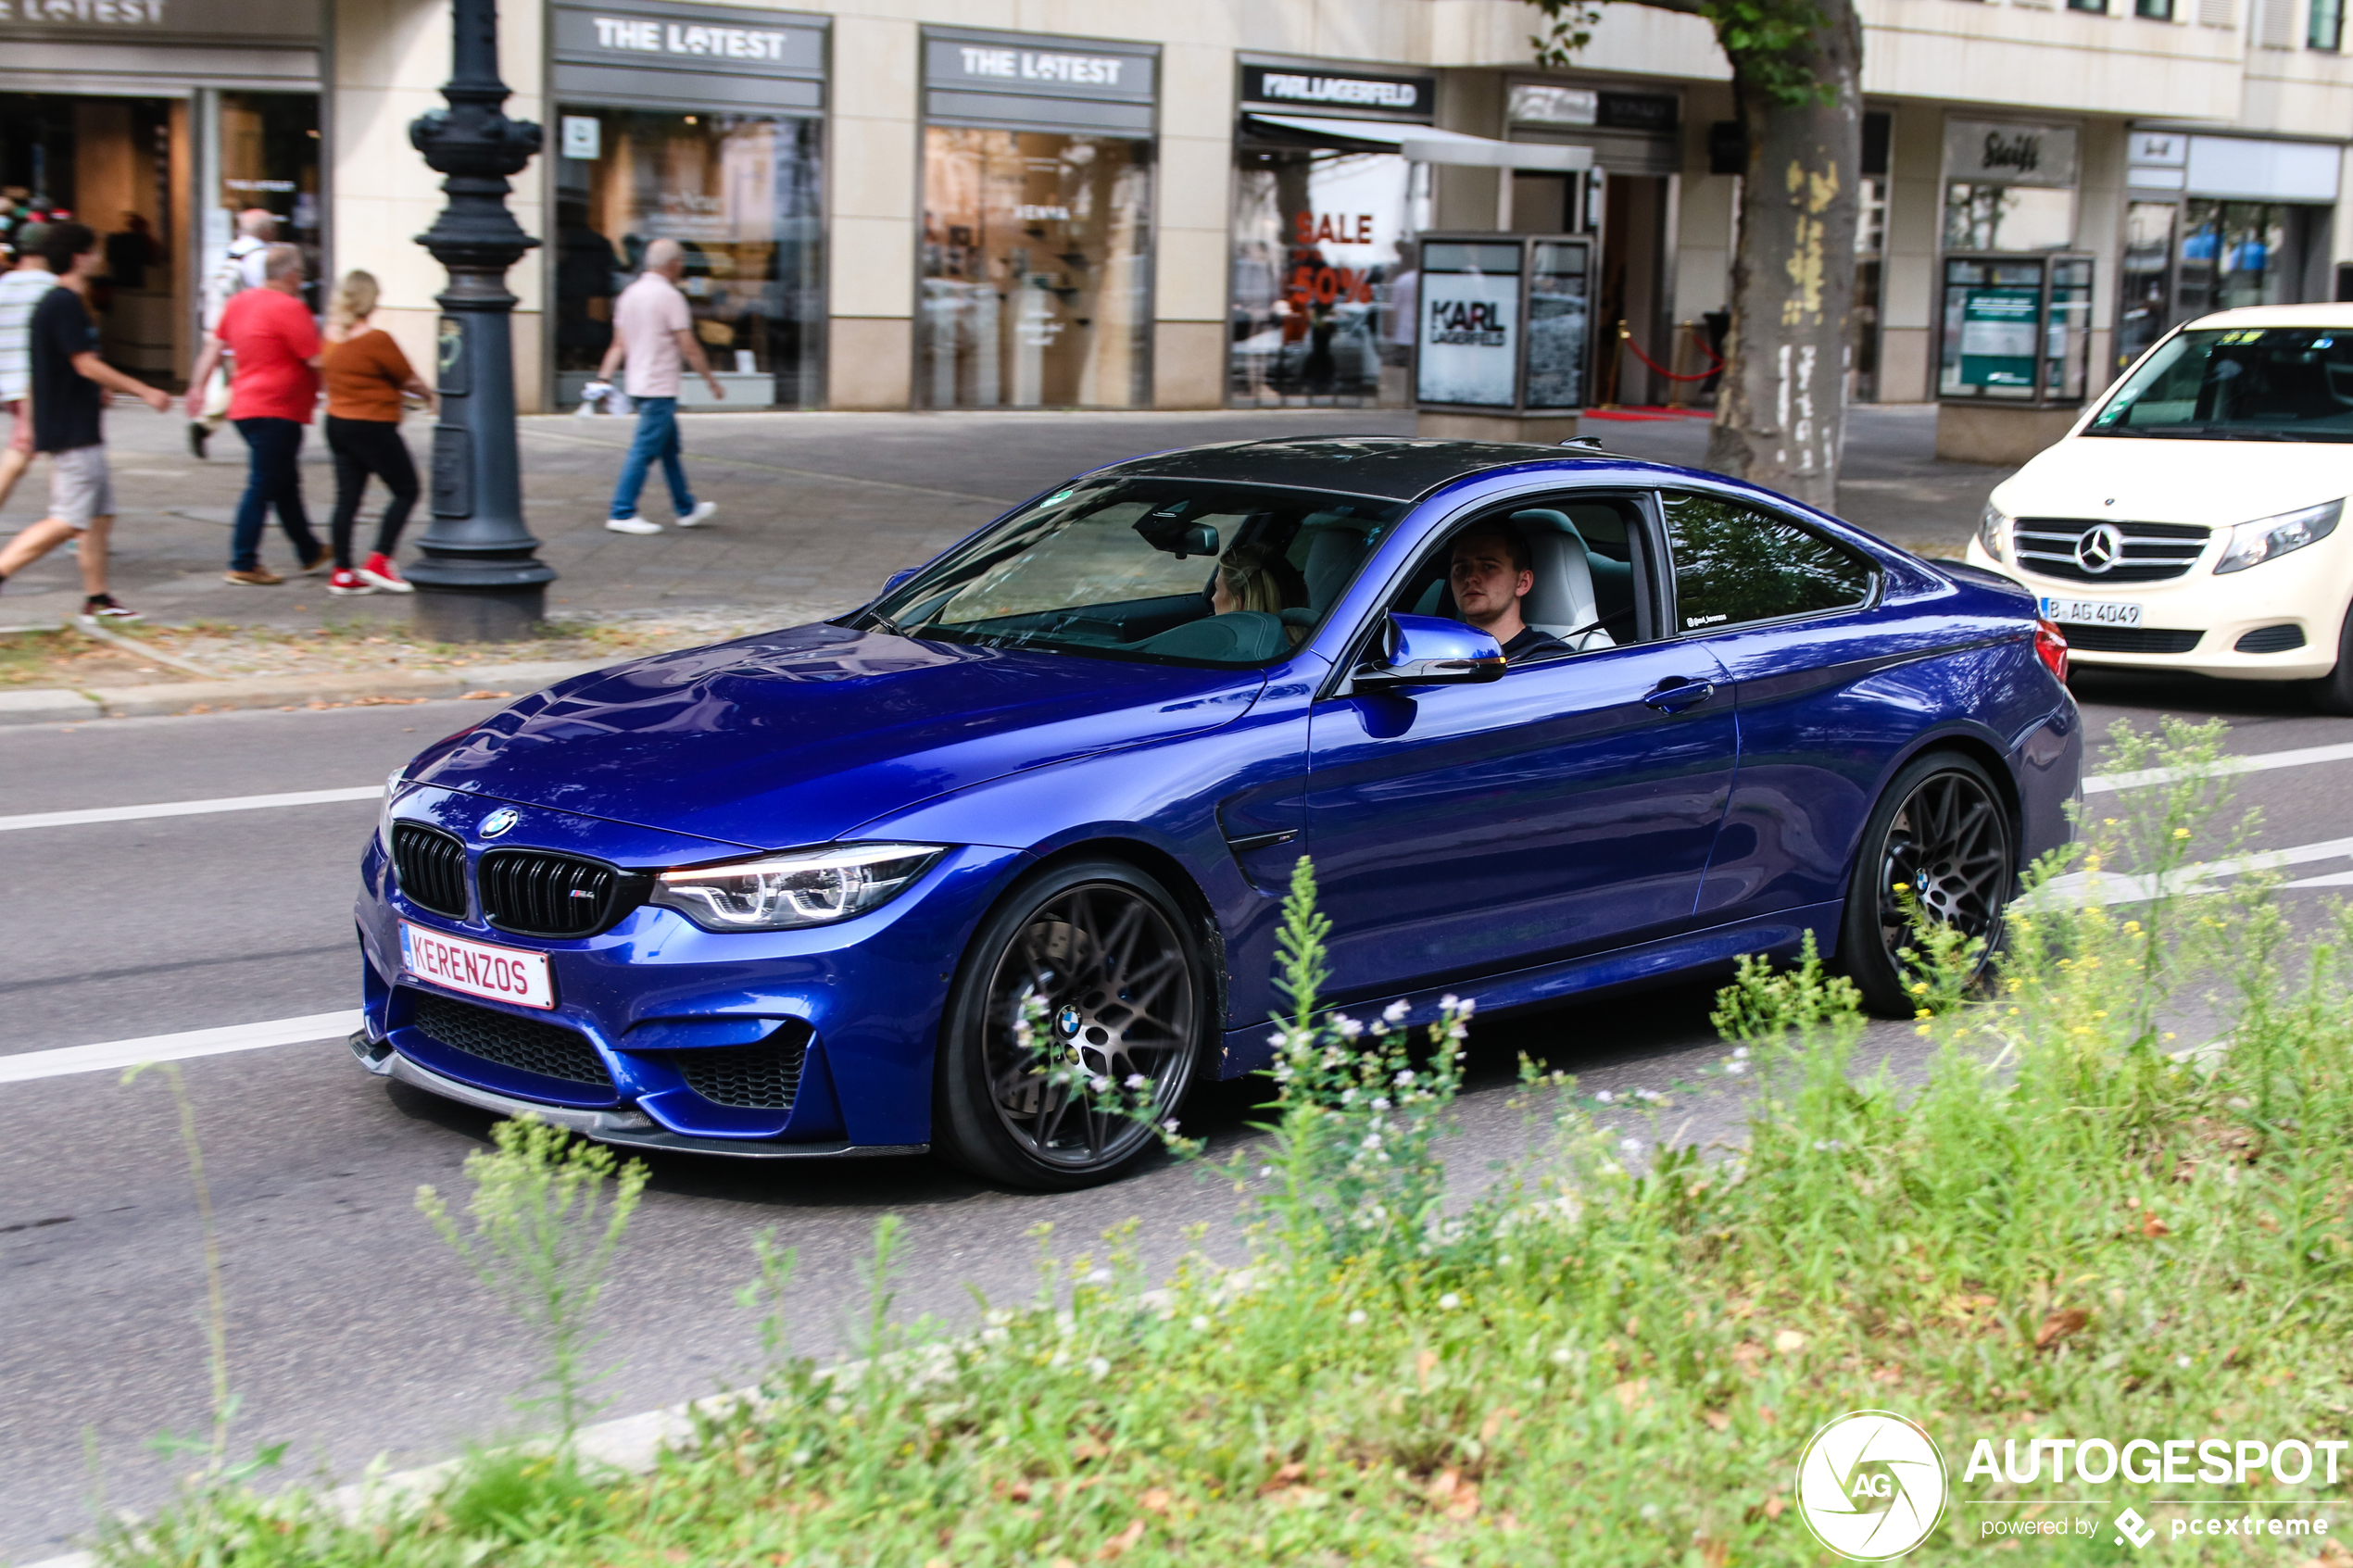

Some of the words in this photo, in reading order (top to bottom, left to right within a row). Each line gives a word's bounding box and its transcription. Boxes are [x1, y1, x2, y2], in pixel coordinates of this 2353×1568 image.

[23, 0, 166, 24] LATEST
[593, 18, 661, 51] THE
[667, 24, 786, 59] LATEST
[960, 47, 1016, 77] THE
[1021, 53, 1122, 84] LATEST
[1295, 210, 1372, 244] SALE
[1293, 266, 1373, 304] 50%
[1431, 300, 1506, 331] KARL
[2050, 601, 2059, 618] B
[2071, 603, 2092, 621] AG
[2096, 605, 2139, 623] 4049
[404, 950, 411, 967] B
[412, 935, 528, 995] KERENZOS
